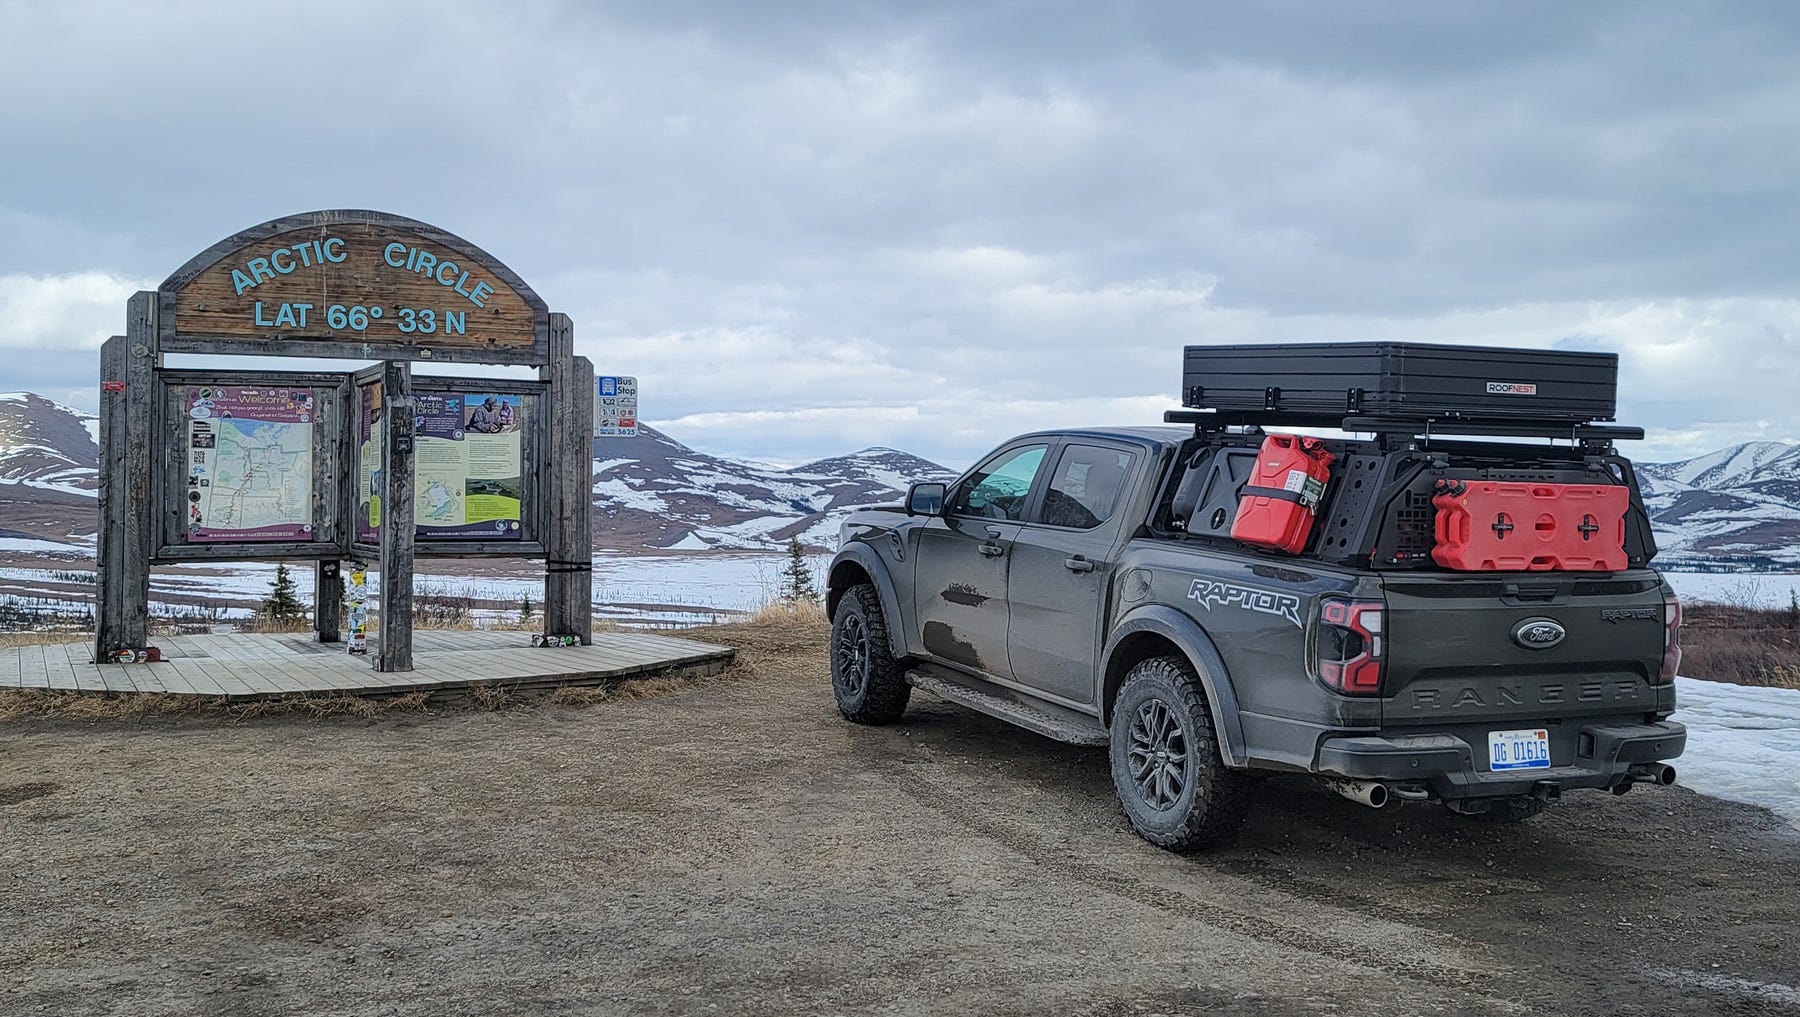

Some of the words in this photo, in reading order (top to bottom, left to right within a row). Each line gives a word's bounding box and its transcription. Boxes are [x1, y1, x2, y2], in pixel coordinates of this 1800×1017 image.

[230, 237, 348, 296] ARCTIC
[383, 242, 495, 308] CIRCLE
[254, 301, 313, 328] LAT
[326, 304, 383, 331] 66°
[397, 308, 437, 333] 33
[445, 310, 466, 335] N
[617, 377, 633, 386] Bus
[1489, 384, 1535, 393] ROOFNEST
[617, 386, 636, 396] Stop
[238, 395, 290, 404] Welcome
[417, 401, 443, 409] Arctic
[1186, 578, 1304, 631] RAPTOR
[1600, 608, 1660, 625] RAPTOR
[1529, 627, 1556, 642] Ford
[1411, 680, 1639, 709] RANGER
[1493, 743, 1507, 762] DG
[1513, 741, 1547, 761] 01616
